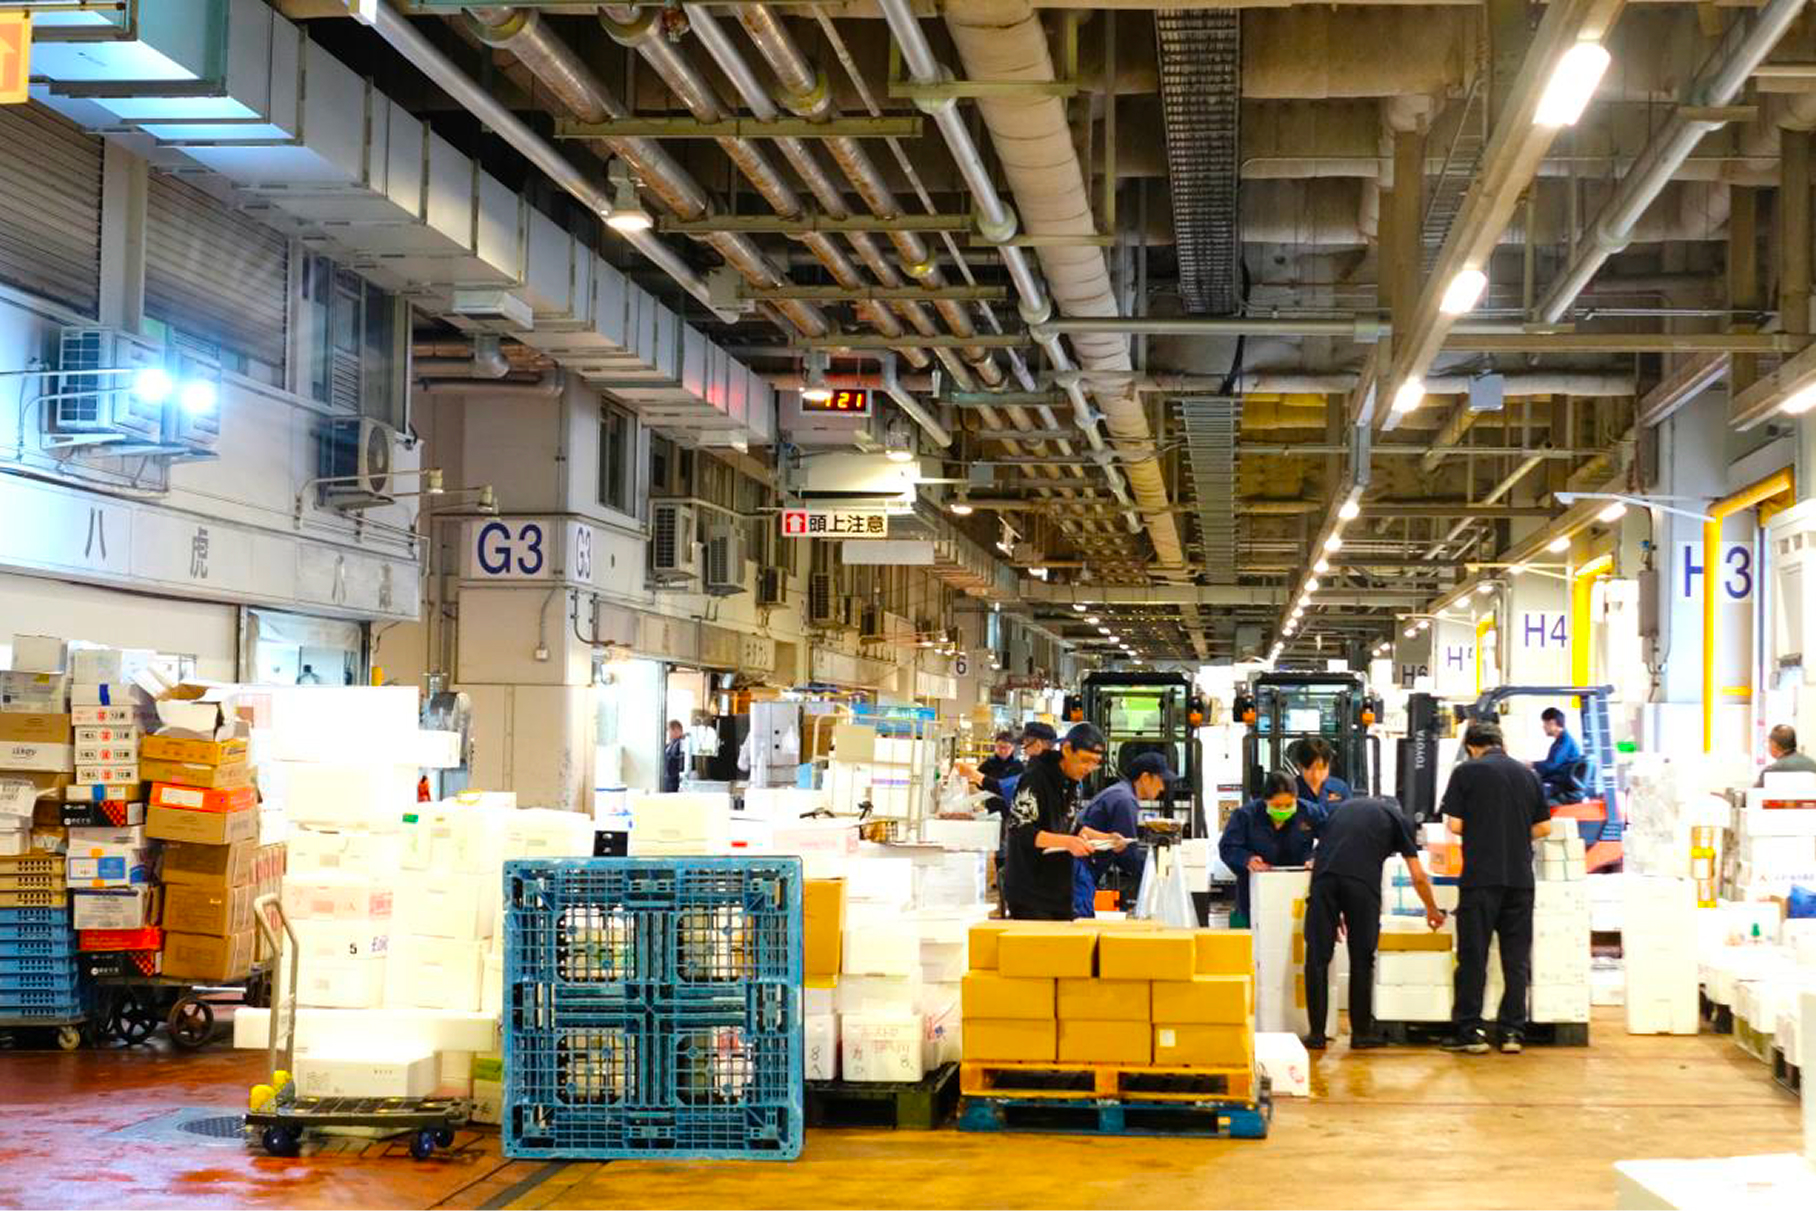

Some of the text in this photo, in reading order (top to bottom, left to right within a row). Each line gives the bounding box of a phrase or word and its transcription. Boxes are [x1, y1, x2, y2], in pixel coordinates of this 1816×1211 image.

[808, 514, 884, 534] 頭上注意
[477, 522, 543, 575] G3
[575, 527, 591, 579] G3
[1684, 545, 1751, 599] H3
[1524, 614, 1567, 648] H4
[1414, 729, 1426, 770] TOYOTA
[349, 942, 358, 955] 5
